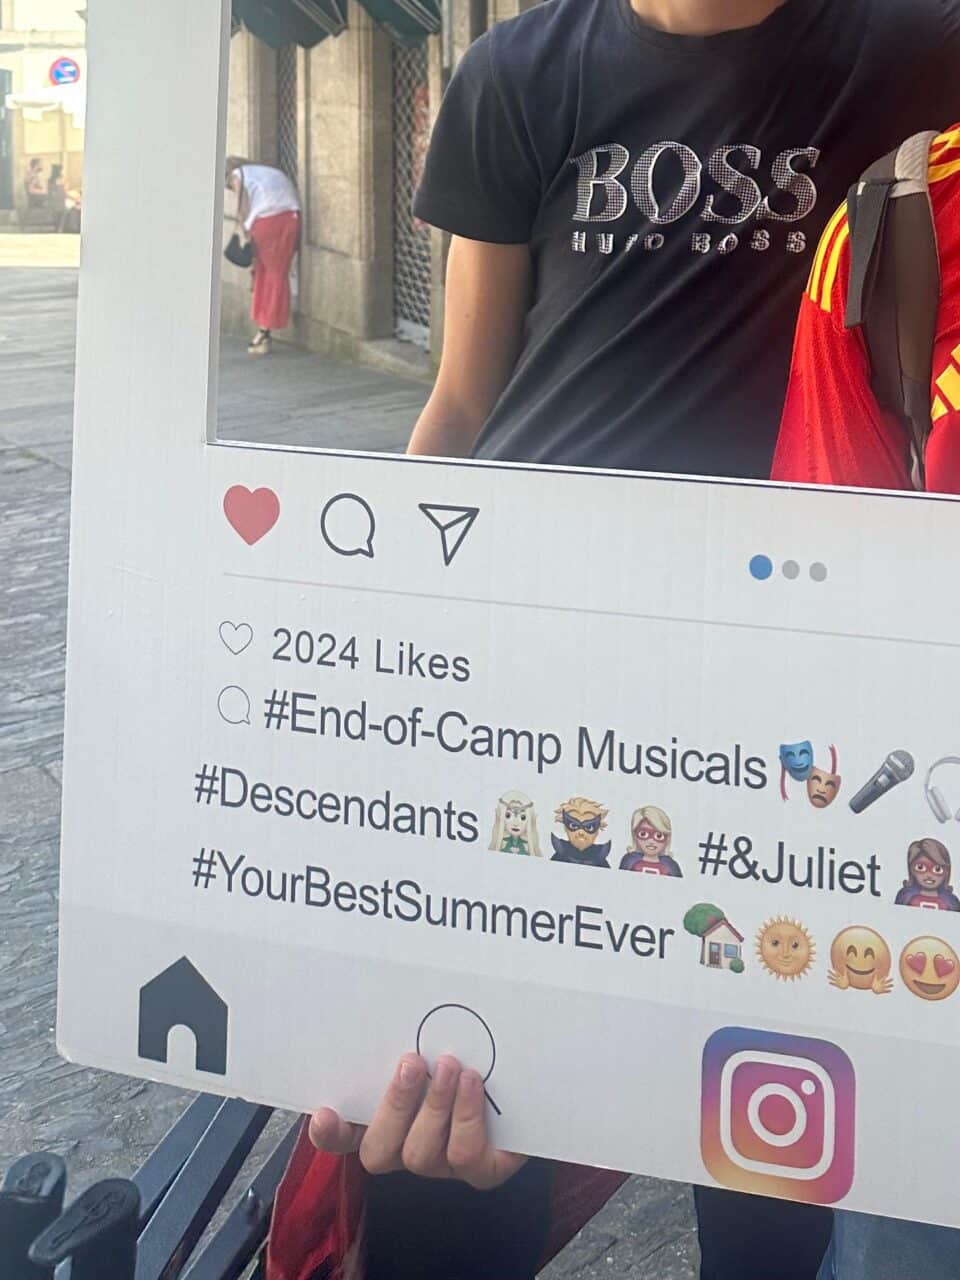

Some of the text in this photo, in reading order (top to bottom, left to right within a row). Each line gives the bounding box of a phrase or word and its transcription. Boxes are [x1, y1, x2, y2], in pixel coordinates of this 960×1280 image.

[569, 140, 821, 225] BOSS
[691, 228, 807, 255] BOSS
[271, 627, 471, 682] 2024 Likes
[263, 688, 768, 790] #End-of-Camp Musicals
[194, 763, 882, 897] #Descendants #&Juliet
[191, 847, 674, 960] #YourBestSummerEver
